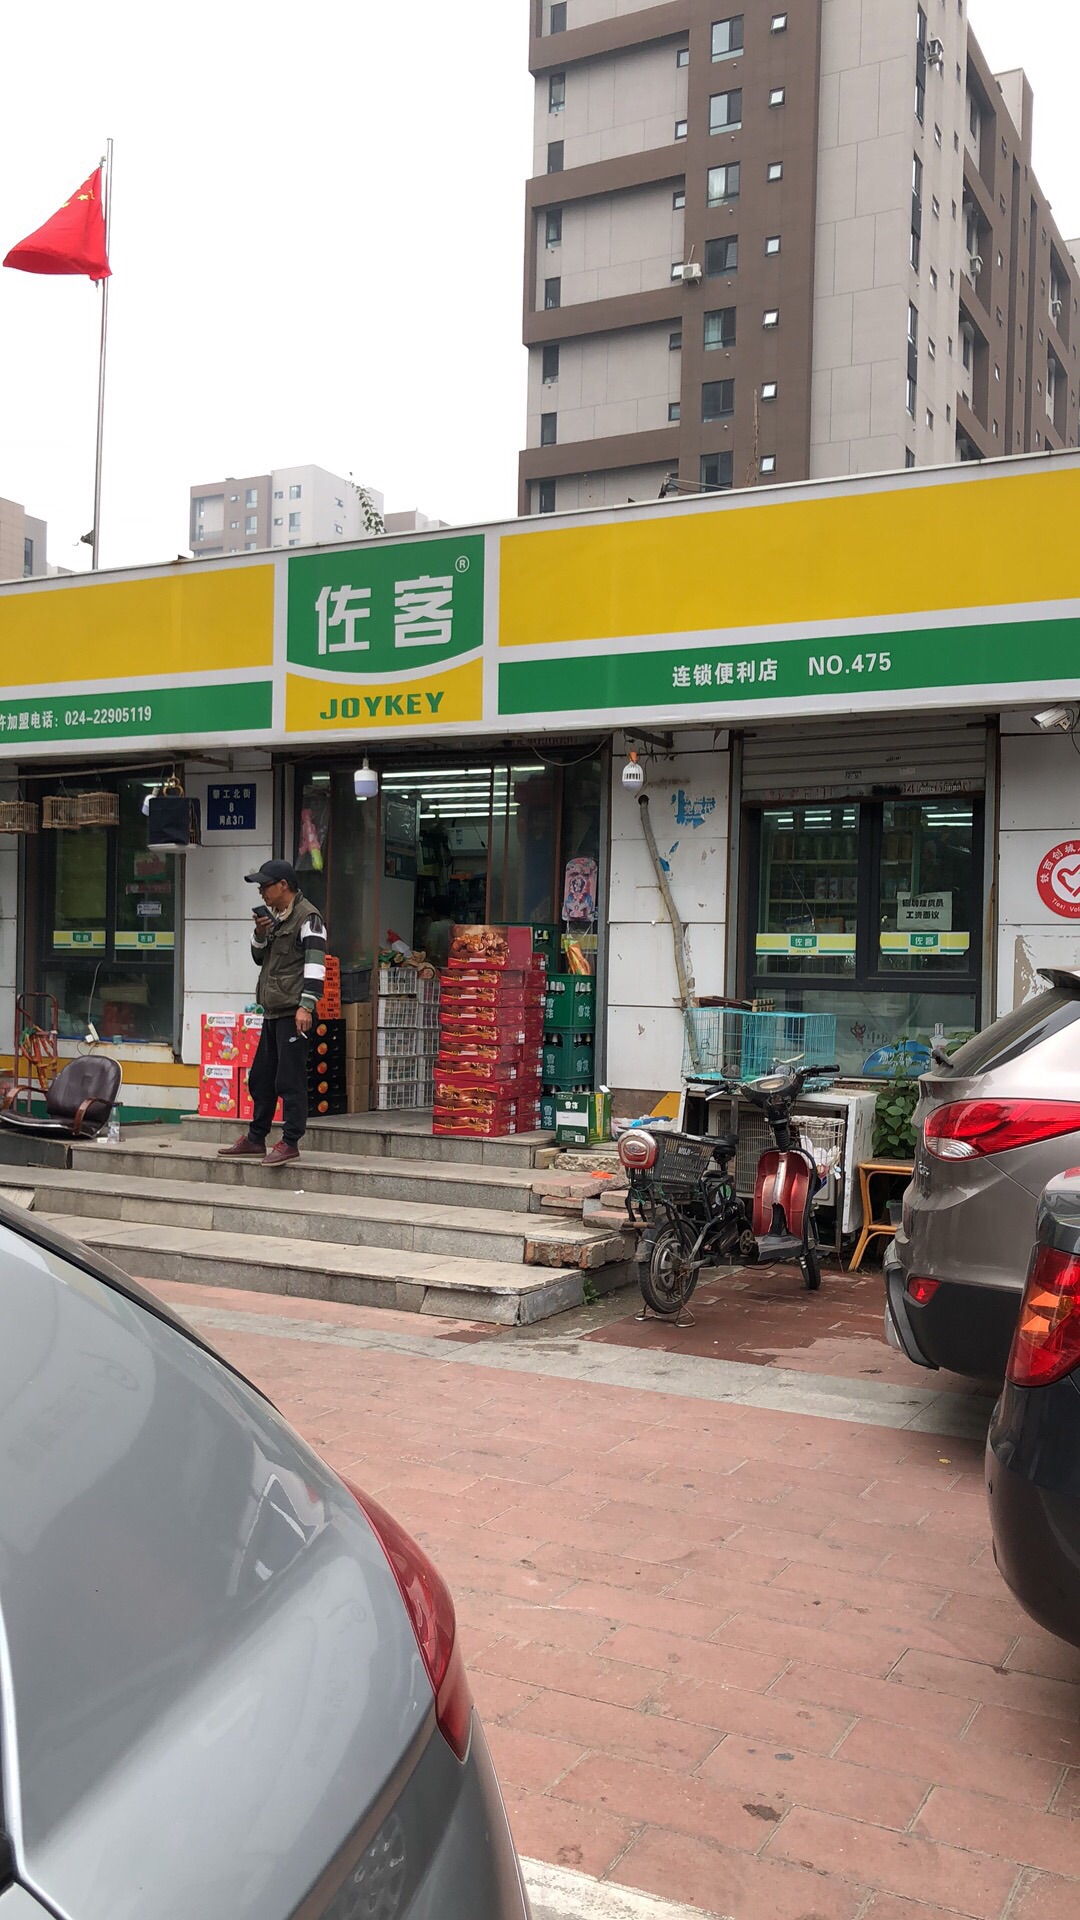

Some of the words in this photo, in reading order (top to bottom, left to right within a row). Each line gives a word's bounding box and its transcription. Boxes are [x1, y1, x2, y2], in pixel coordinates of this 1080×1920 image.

[315, 575, 454, 655] 佐客
[672, 658, 778, 688] 连锁便利店
[808, 652, 892, 676] NO.475
[319, 691, 445, 720] JOYKEY
[229, 802, 235, 813] 8
[1040, 843, 1080, 884] 铁西创城
